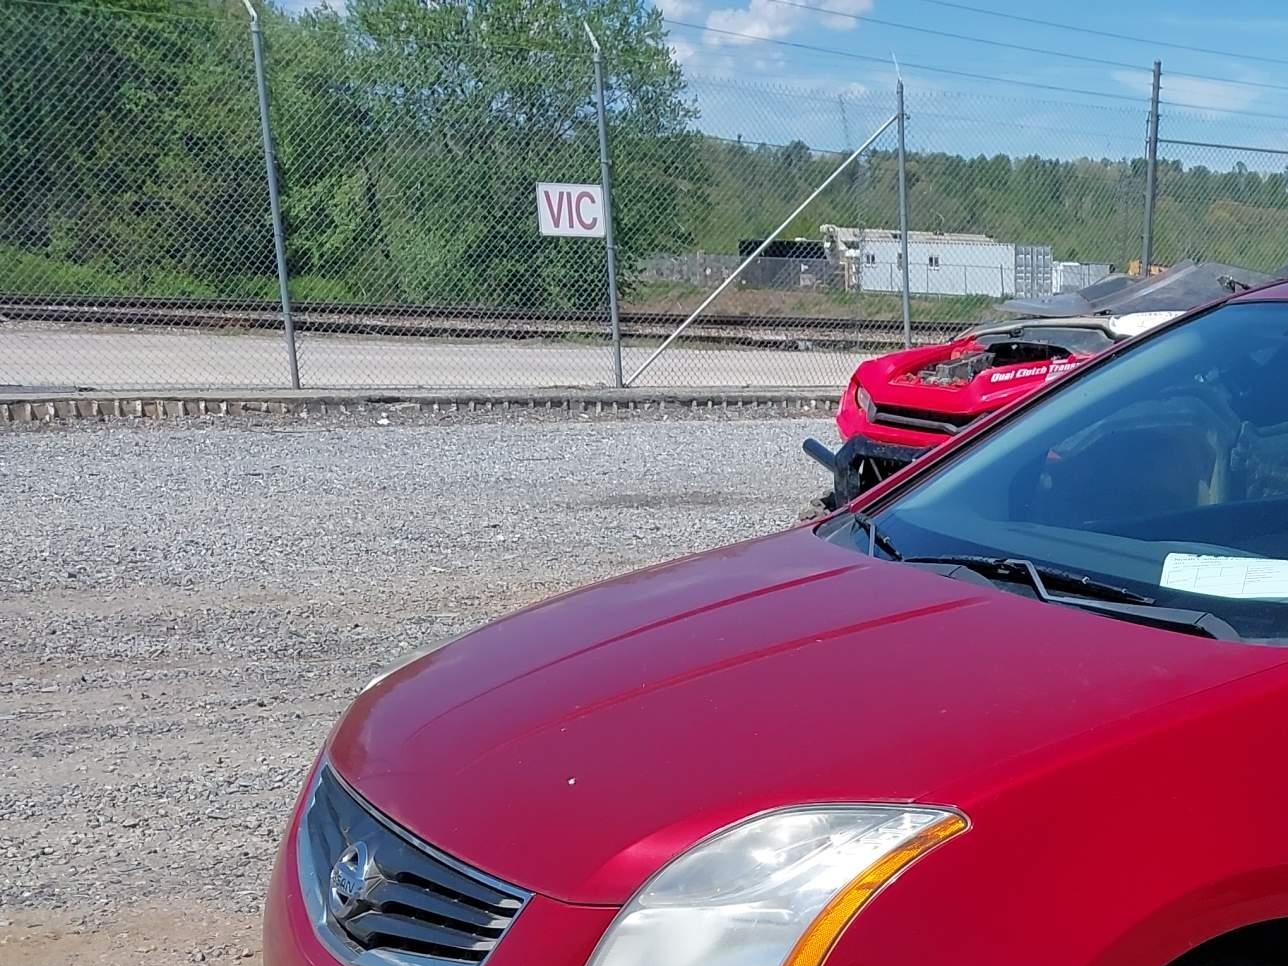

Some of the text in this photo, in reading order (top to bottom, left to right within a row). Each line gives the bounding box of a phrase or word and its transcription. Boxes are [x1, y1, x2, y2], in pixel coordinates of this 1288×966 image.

[543, 190, 598, 230] VIC
[991, 370, 1014, 382] Dual
[1016, 366, 1047, 378] Clutch
